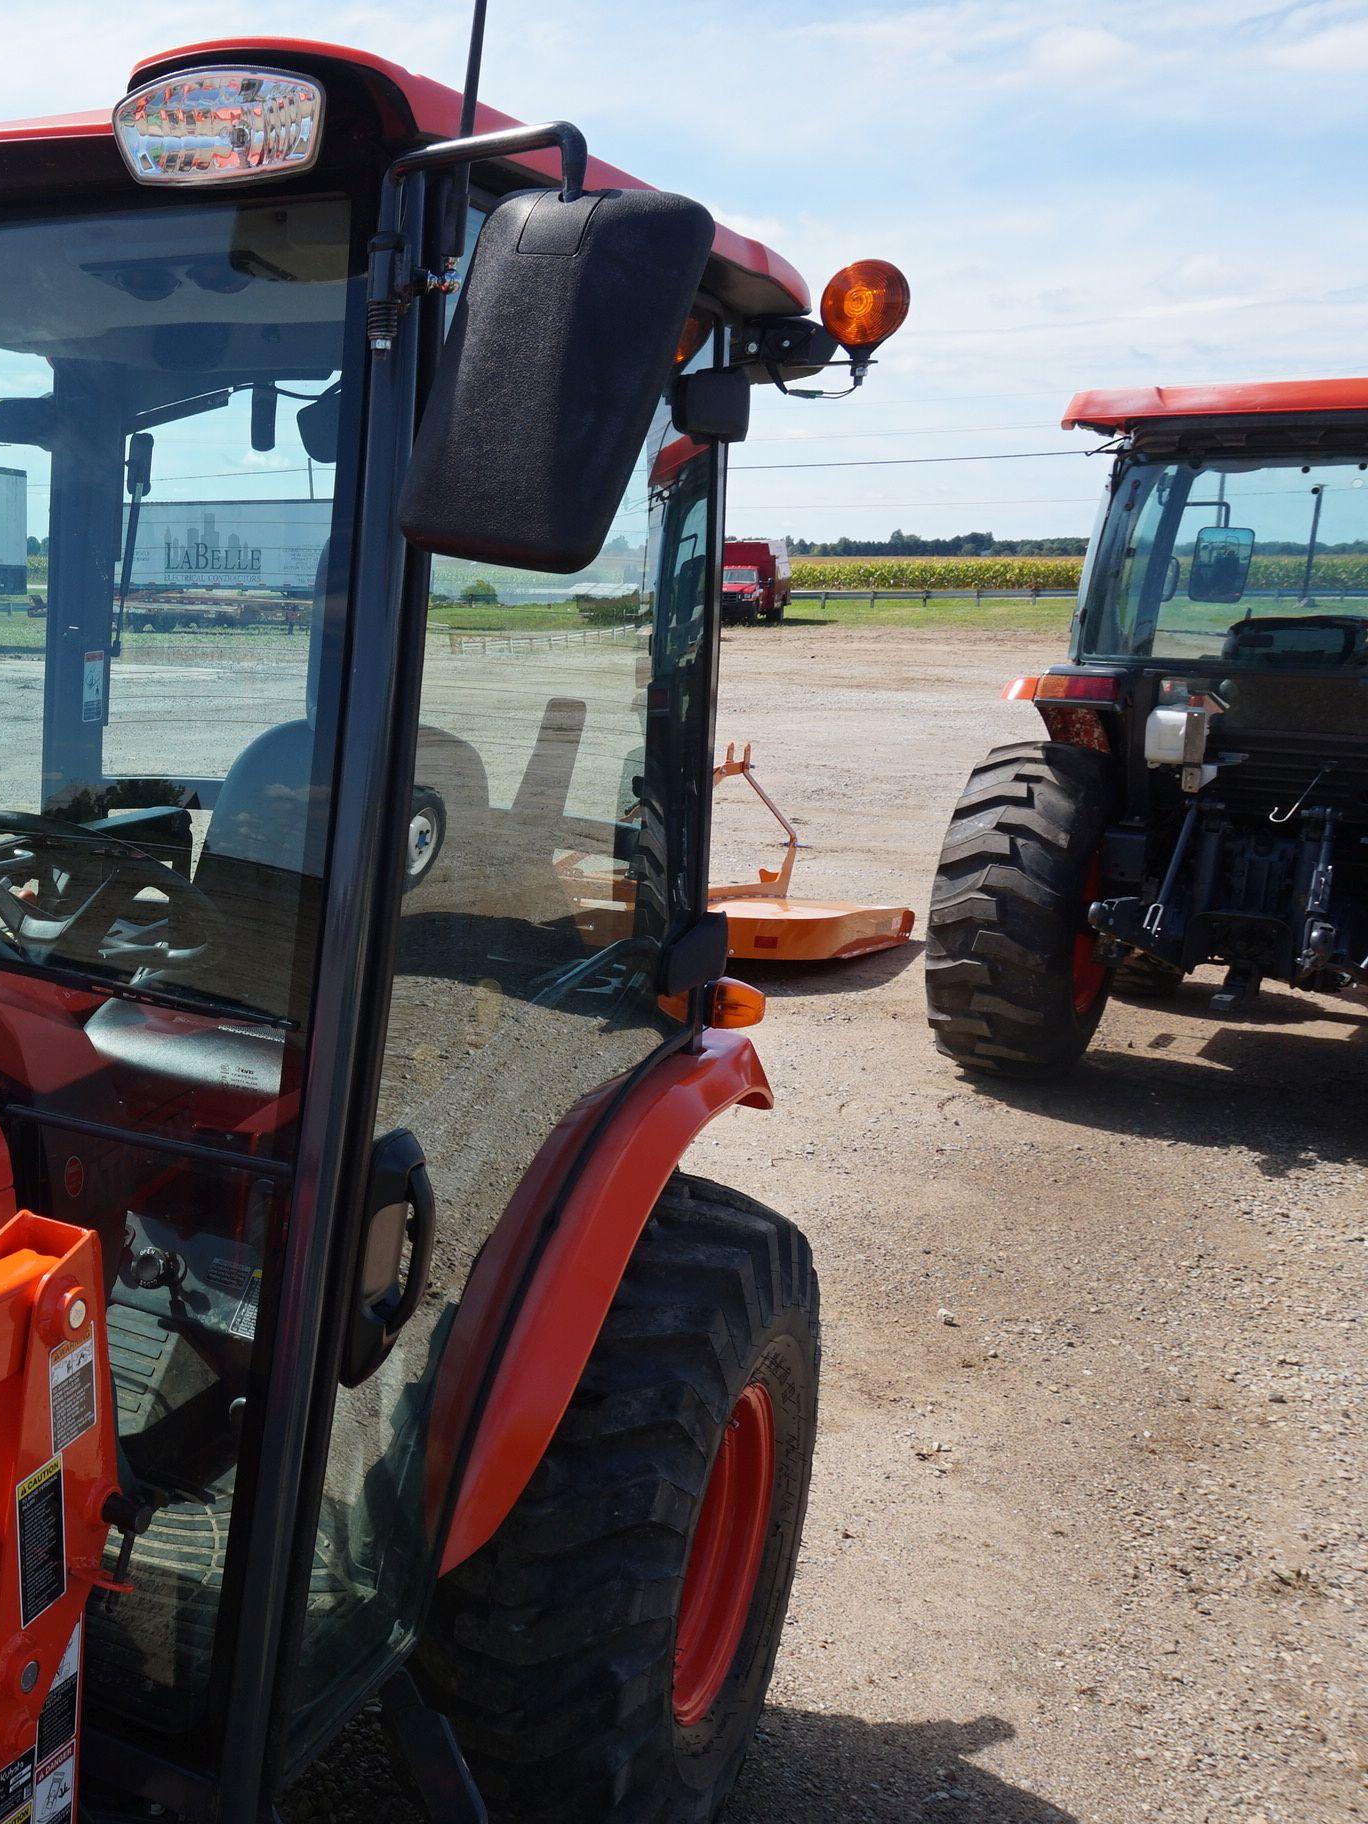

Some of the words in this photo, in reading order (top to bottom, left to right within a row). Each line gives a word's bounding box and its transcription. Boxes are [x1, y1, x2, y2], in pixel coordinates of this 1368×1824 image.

[164, 574, 204, 582] ELECTRICAL
[208, 574, 262, 583] CONTRACTORS
[27, 1460, 60, 1489] CAUTION
[45, 1747, 72, 1772] DANGER
[0, 1761, 24, 1782] Kubota
